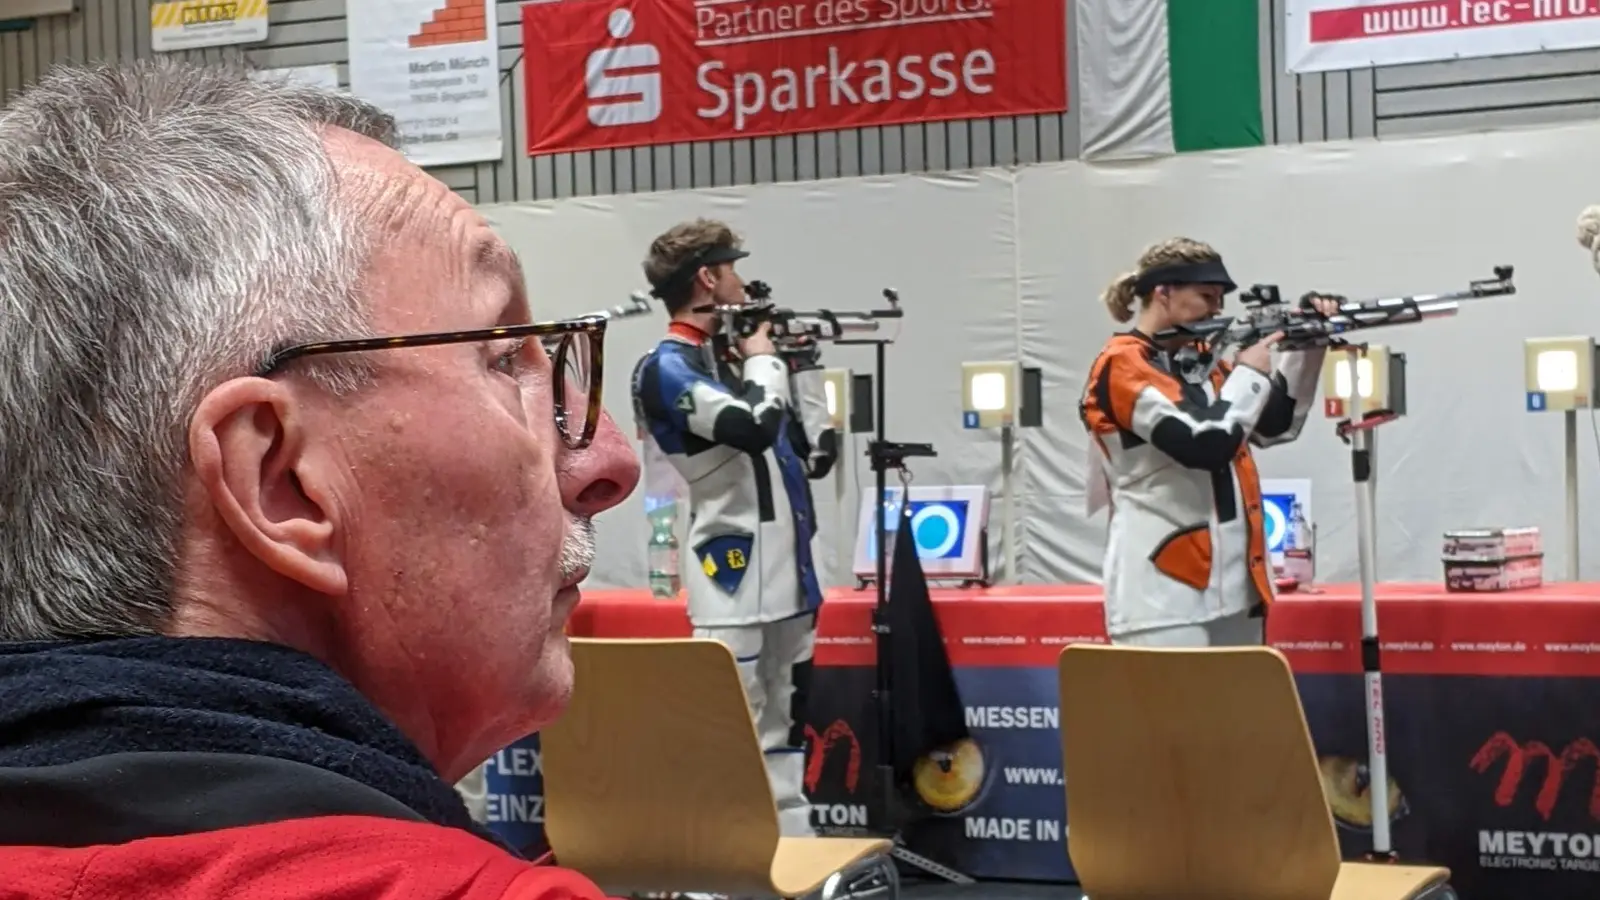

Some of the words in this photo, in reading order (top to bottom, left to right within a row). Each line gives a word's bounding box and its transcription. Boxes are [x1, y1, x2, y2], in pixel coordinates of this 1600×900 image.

[696, 4, 806, 38] Partner
[814, 0, 868, 25] des
[696, 46, 995, 130] Sparkasse
[965, 706, 1059, 728] MESSEN
[965, 817, 1031, 840] MADE
[1036, 820, 1059, 841] IN
[1478, 829, 1600, 858] MEYTO
